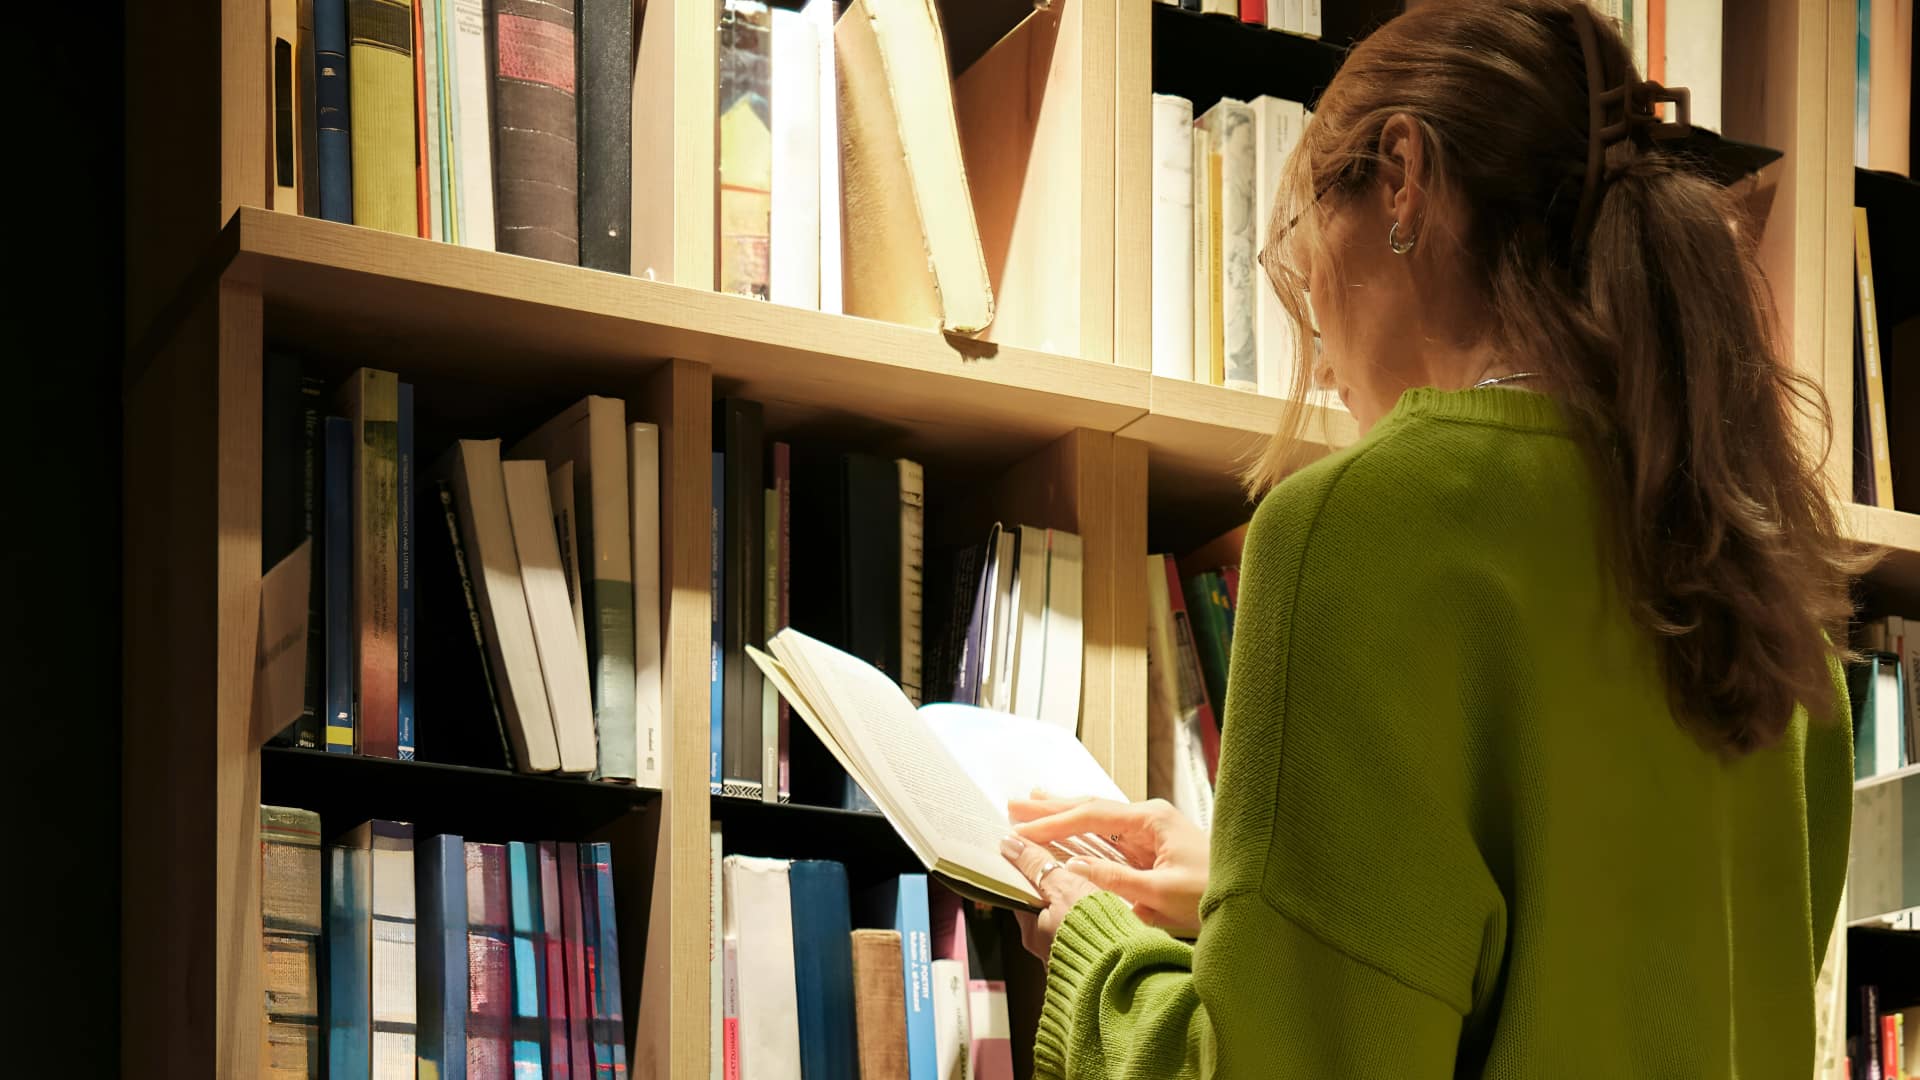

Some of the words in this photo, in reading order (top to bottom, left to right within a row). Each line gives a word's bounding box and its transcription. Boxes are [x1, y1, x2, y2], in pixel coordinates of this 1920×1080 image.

[402, 551, 410, 590] LITERATURE
[920, 931, 928, 962] ARABIC
[921, 965, 929, 998] POETRY
